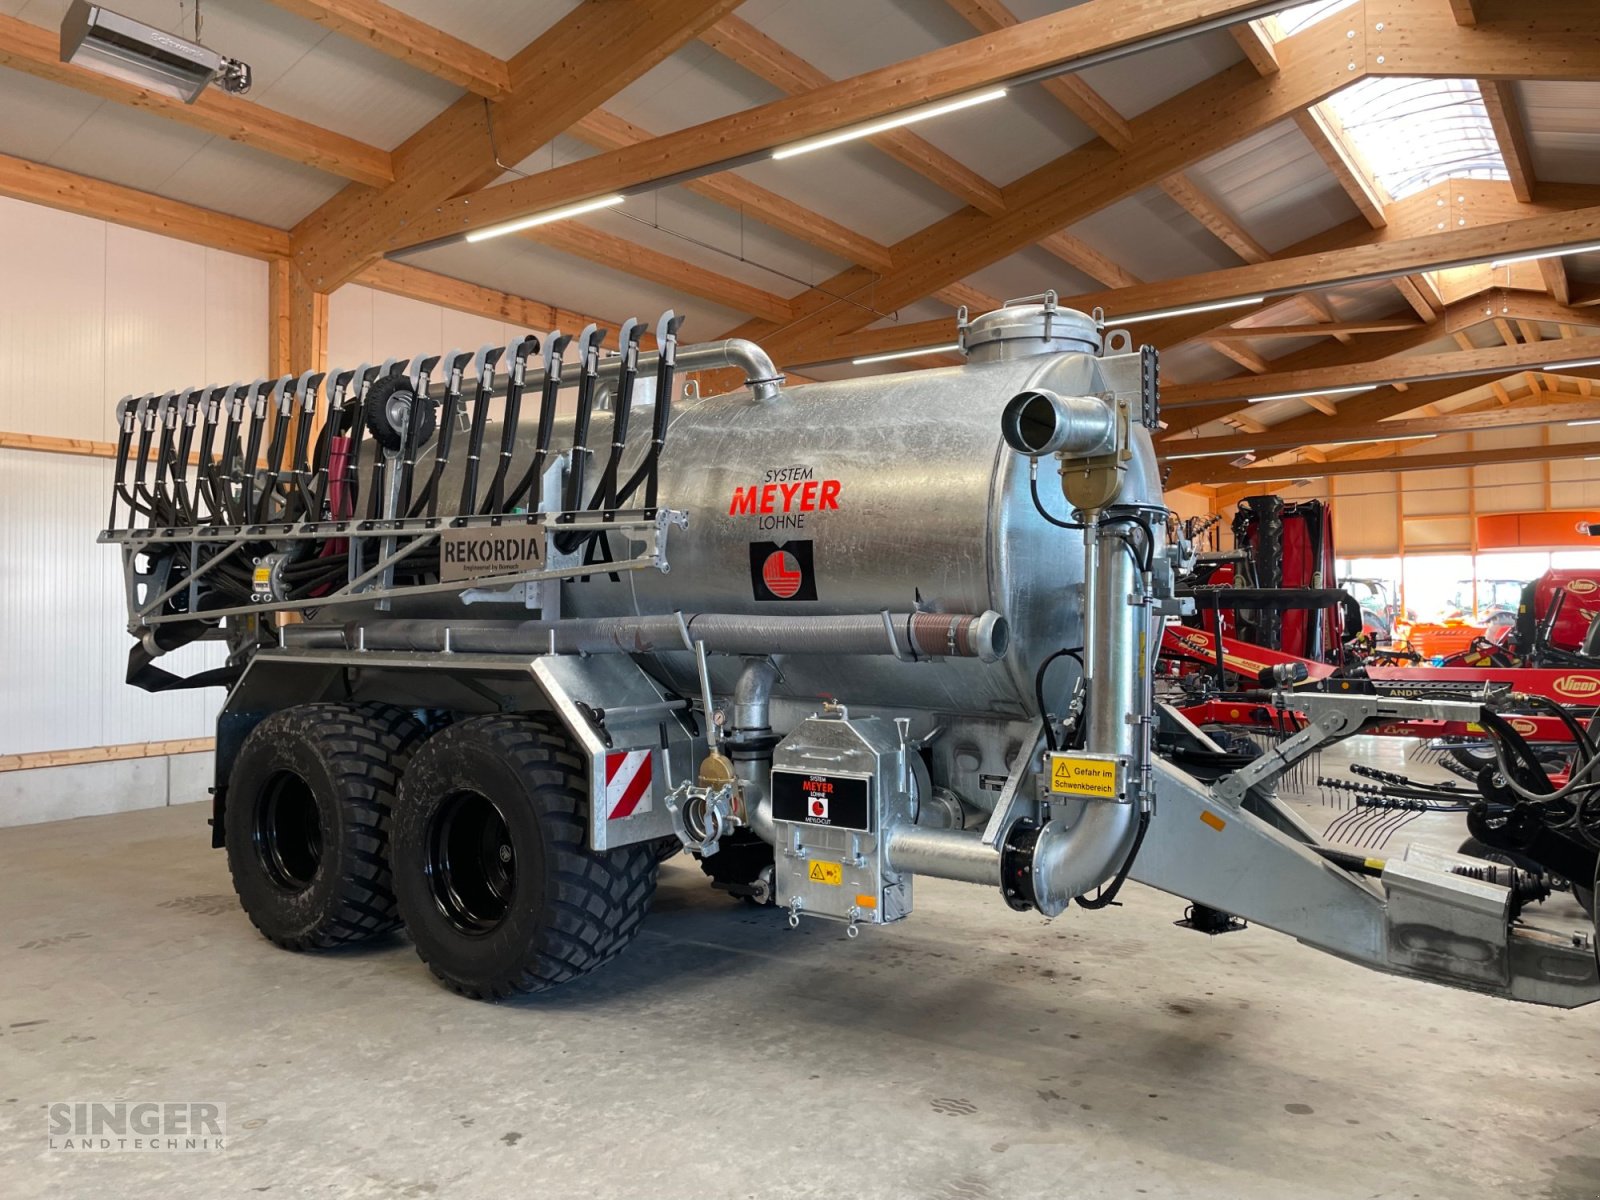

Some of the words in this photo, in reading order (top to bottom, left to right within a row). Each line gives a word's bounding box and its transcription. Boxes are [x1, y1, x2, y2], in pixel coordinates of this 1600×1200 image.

[764, 467, 814, 483] SYSTEM
[728, 480, 842, 516] MEYER
[759, 514, 805, 530] LOHNE
[444, 538, 540, 563] REKORDIA
[1560, 676, 1598, 692] Vicon
[1074, 767, 1101, 777] Gefahr
[1102, 769, 1113, 778] im
[802, 781, 834, 793] MEYER
[1054, 779, 1112, 793] Schwenkbereich
